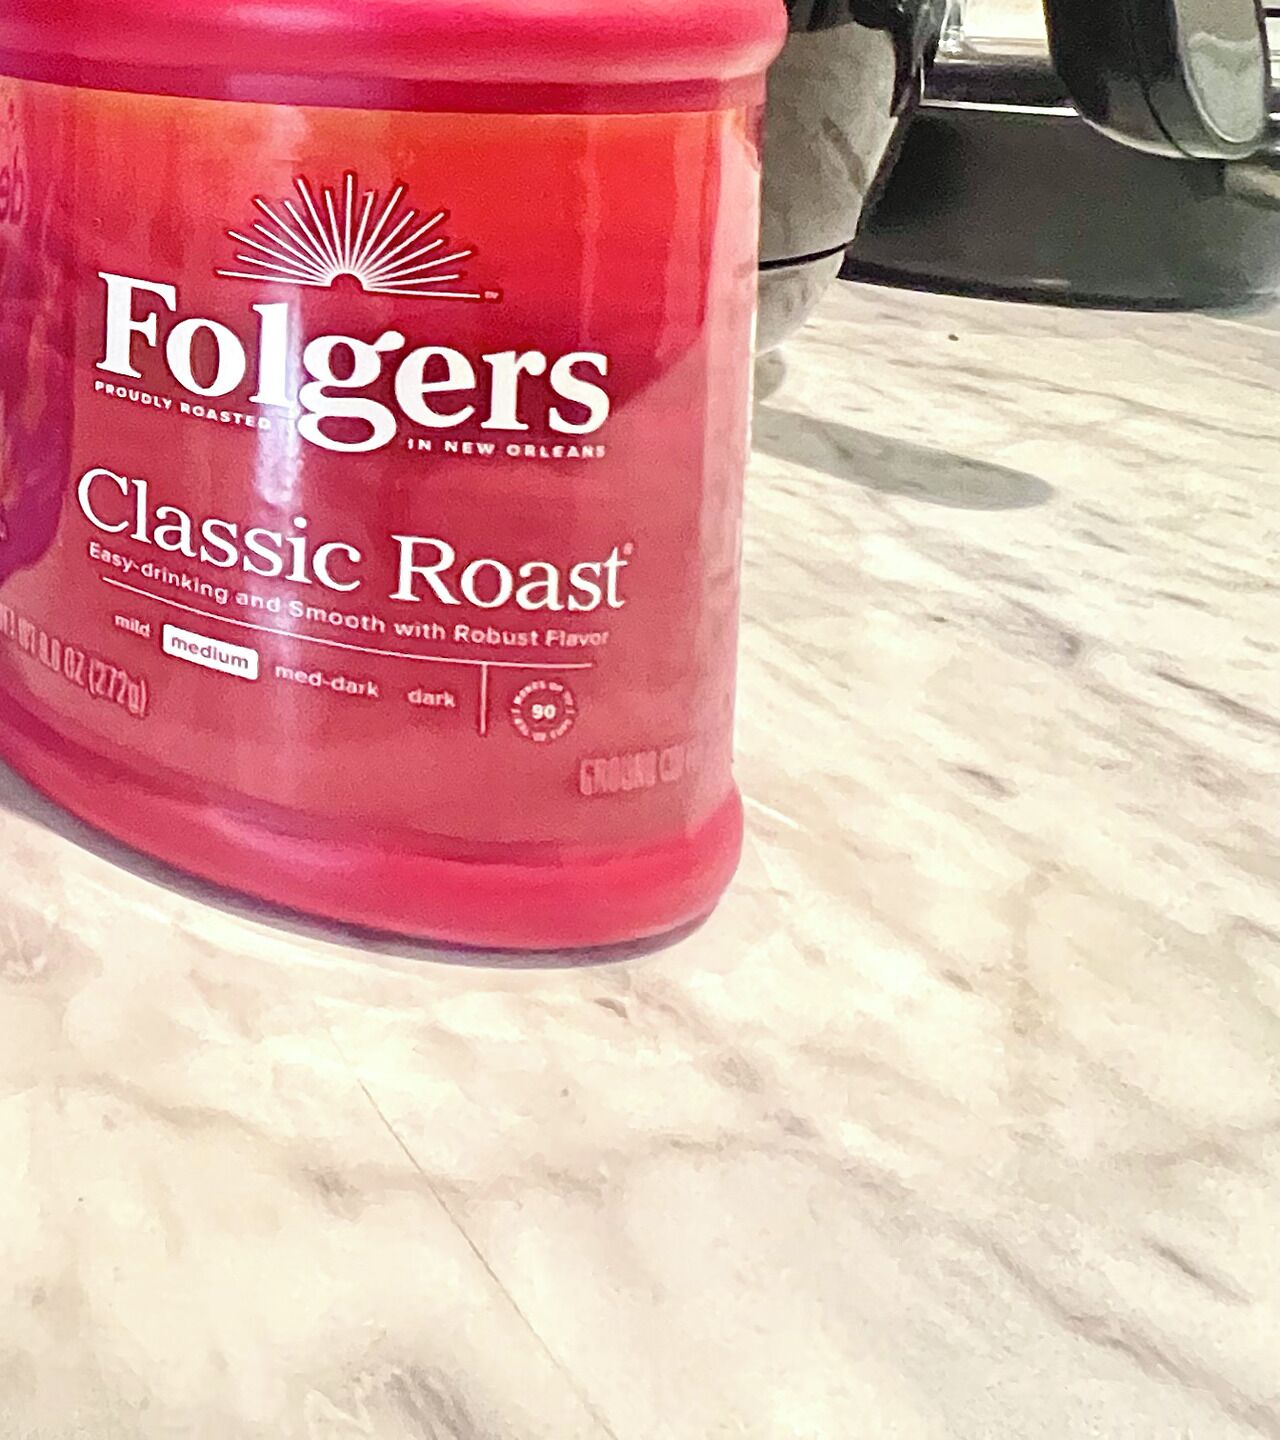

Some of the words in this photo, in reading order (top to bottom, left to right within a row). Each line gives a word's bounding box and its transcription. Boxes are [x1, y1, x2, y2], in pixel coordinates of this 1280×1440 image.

[96, 271, 610, 452] Folgers
[94, 381, 172, 410] PROUDLY
[180, 402, 272, 430] ROASTED
[407, 438, 431, 451] IN
[444, 440, 494, 456] NEW
[506, 444, 606, 459] ORLEANS
[78, 468, 361, 591] Classic
[390, 534, 627, 612] Roast
[89, 542, 228, 604] Easy-drinking
[236, 591, 281, 613] and
[289, 601, 386, 633] Smooth
[394, 622, 446, 640] with
[454, 624, 538, 647] Robust
[546, 629, 609, 648] Flavor
[114, 614, 150, 638] mild
[171, 634, 249, 670] medium
[275, 666, 379, 698] med-dark
[408, 687, 456, 708] dark
[531, 703, 557, 720] 90
